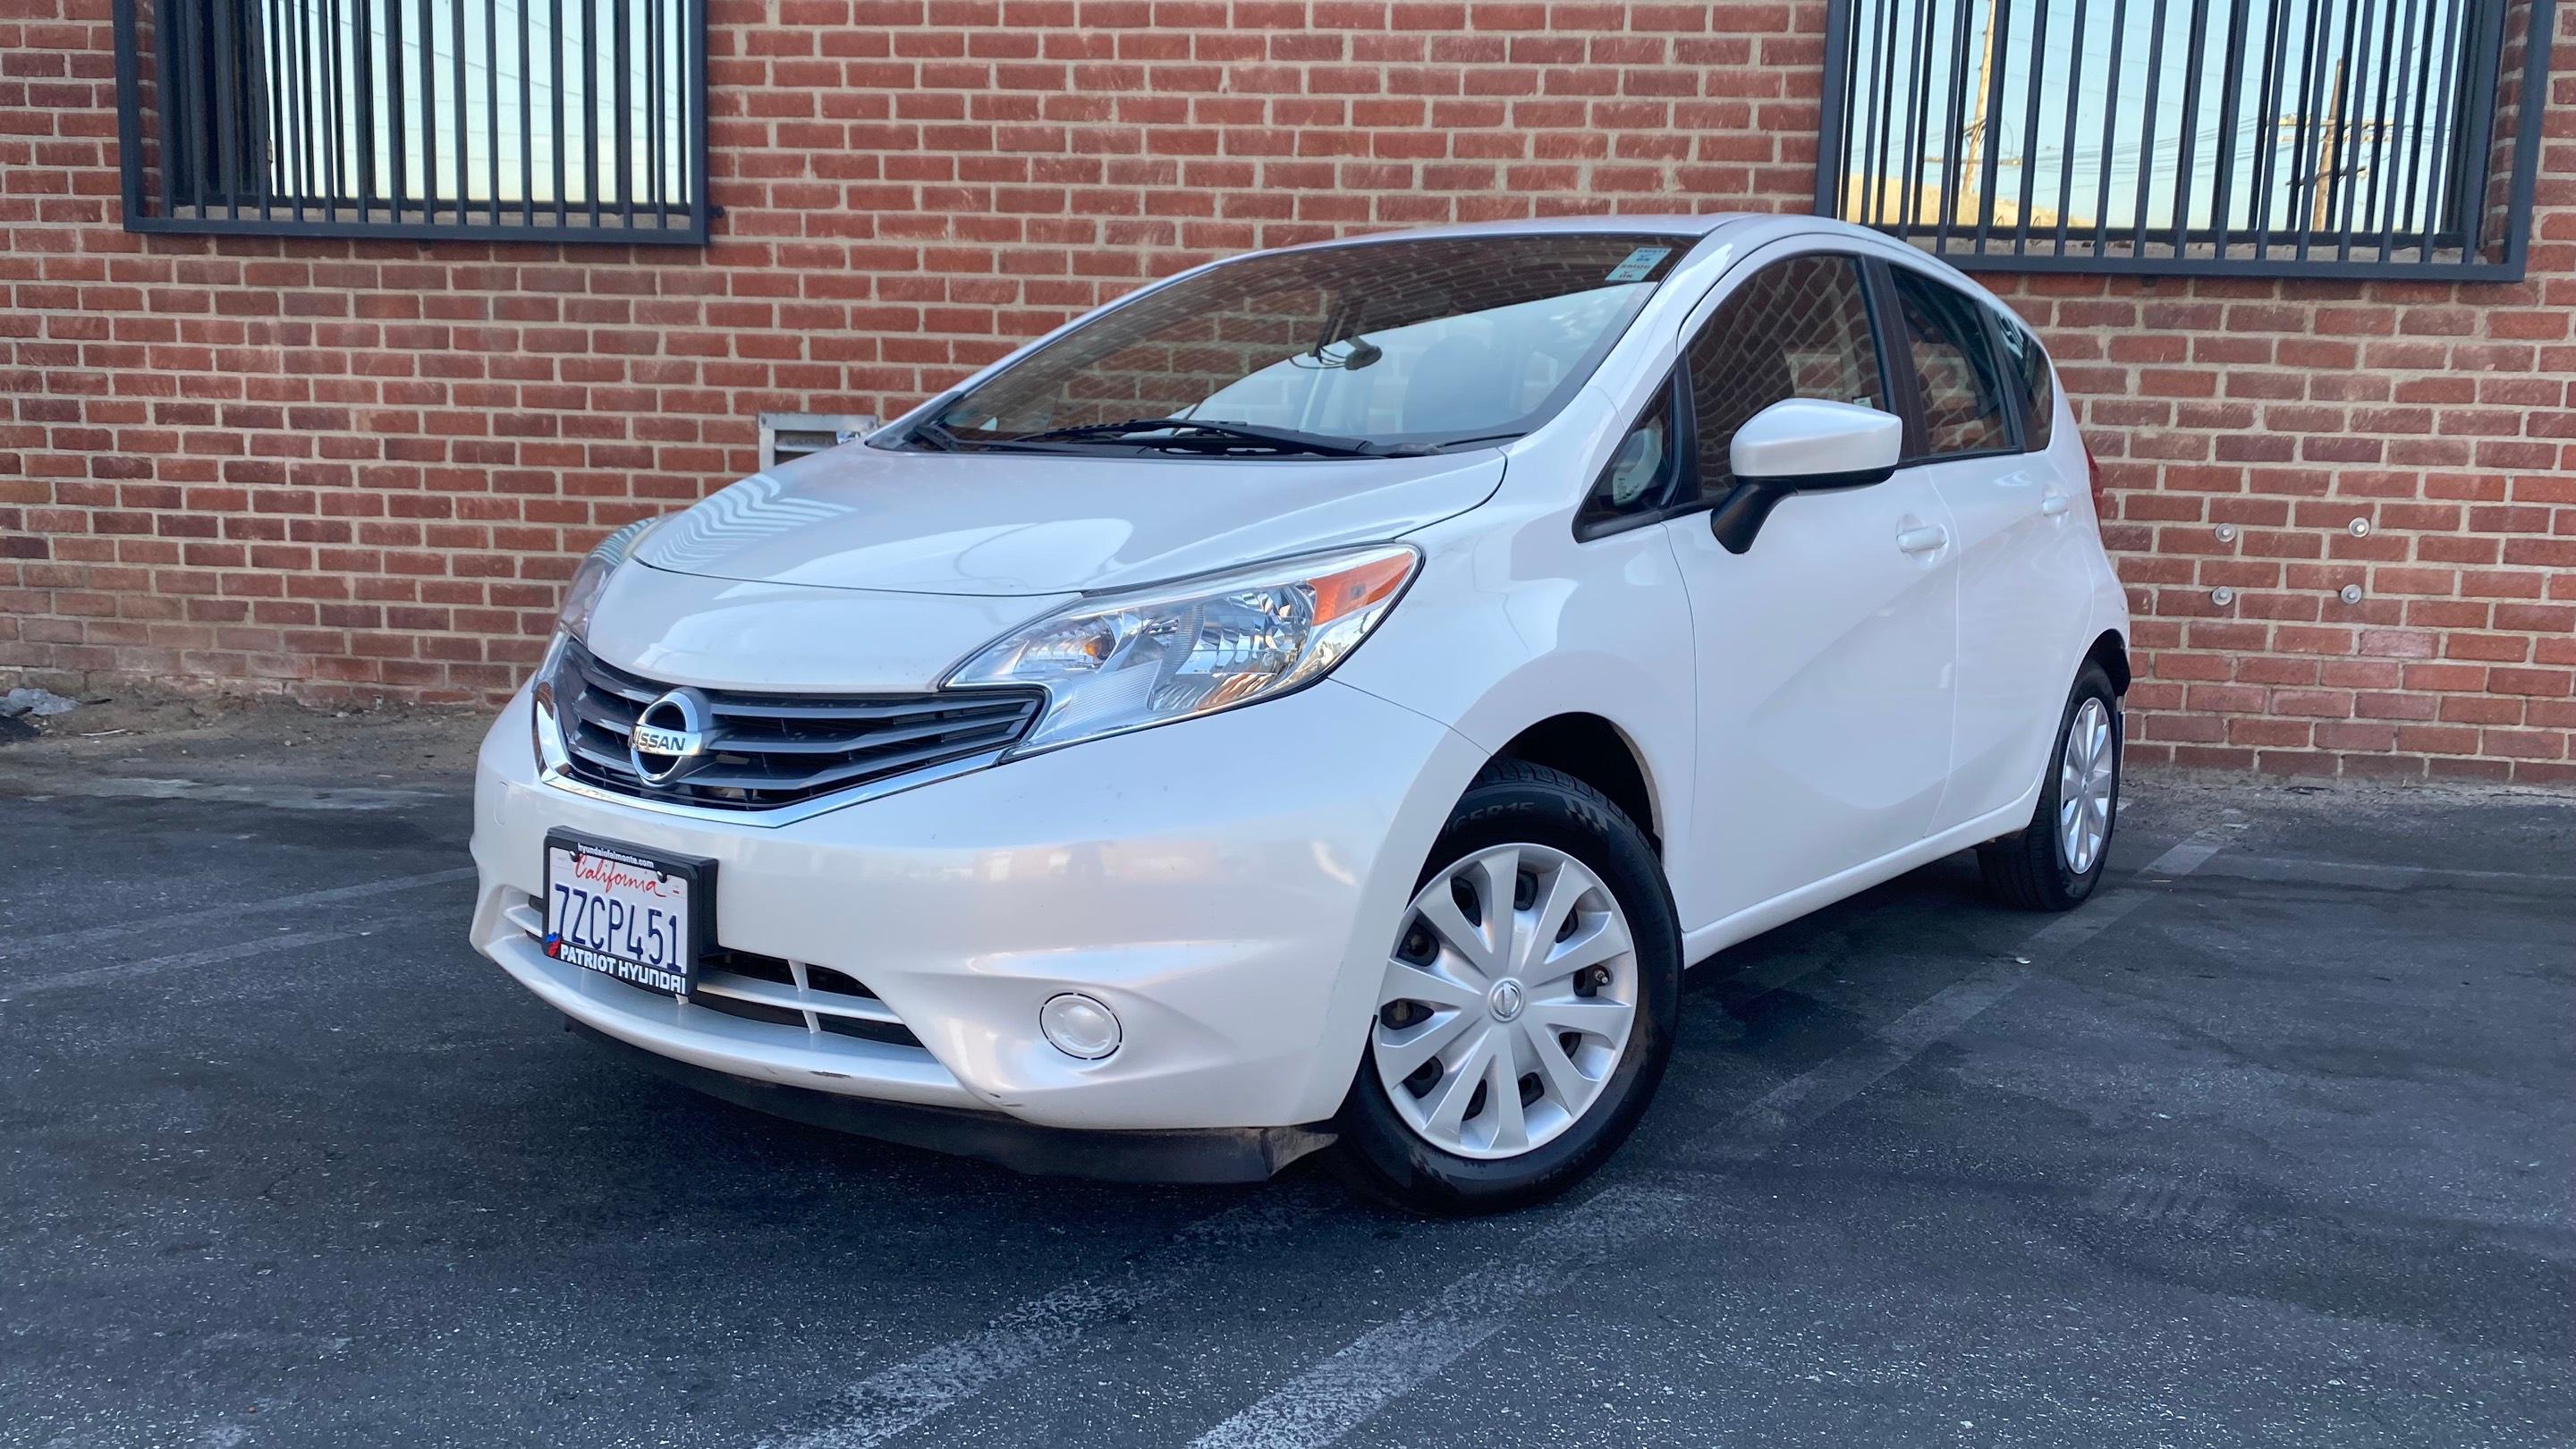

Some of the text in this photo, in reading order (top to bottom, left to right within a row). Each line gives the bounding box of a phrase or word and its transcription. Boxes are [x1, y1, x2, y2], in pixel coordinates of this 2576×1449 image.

[631, 728, 686, 751] NISSAN
[573, 852, 666, 898] California
[555, 883, 682, 974] 7ZCP451
[560, 944, 687, 995] PATRIOT HYUNDAI
